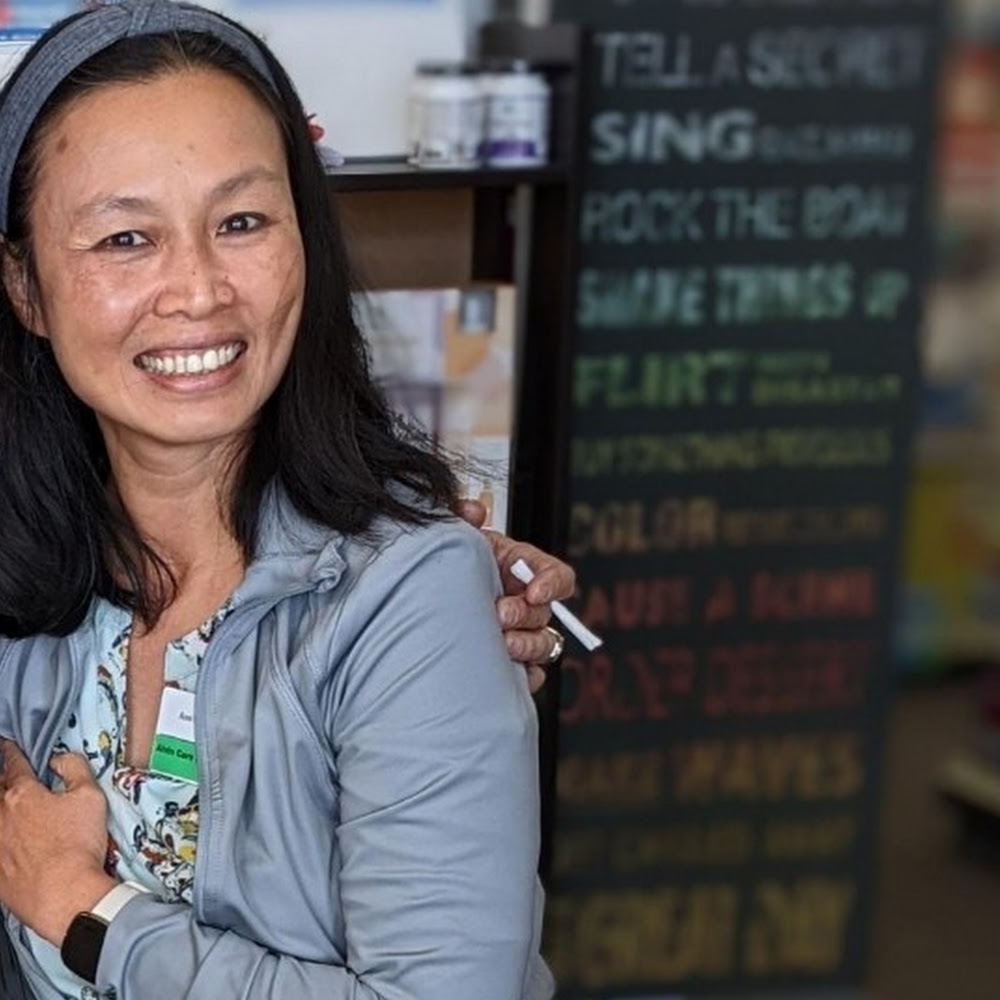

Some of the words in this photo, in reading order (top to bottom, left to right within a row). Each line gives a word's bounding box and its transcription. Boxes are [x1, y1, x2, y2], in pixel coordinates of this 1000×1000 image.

[591, 108, 756, 163] SING
[581, 188, 702, 244] ROCK
[711, 187, 793, 240] THE
